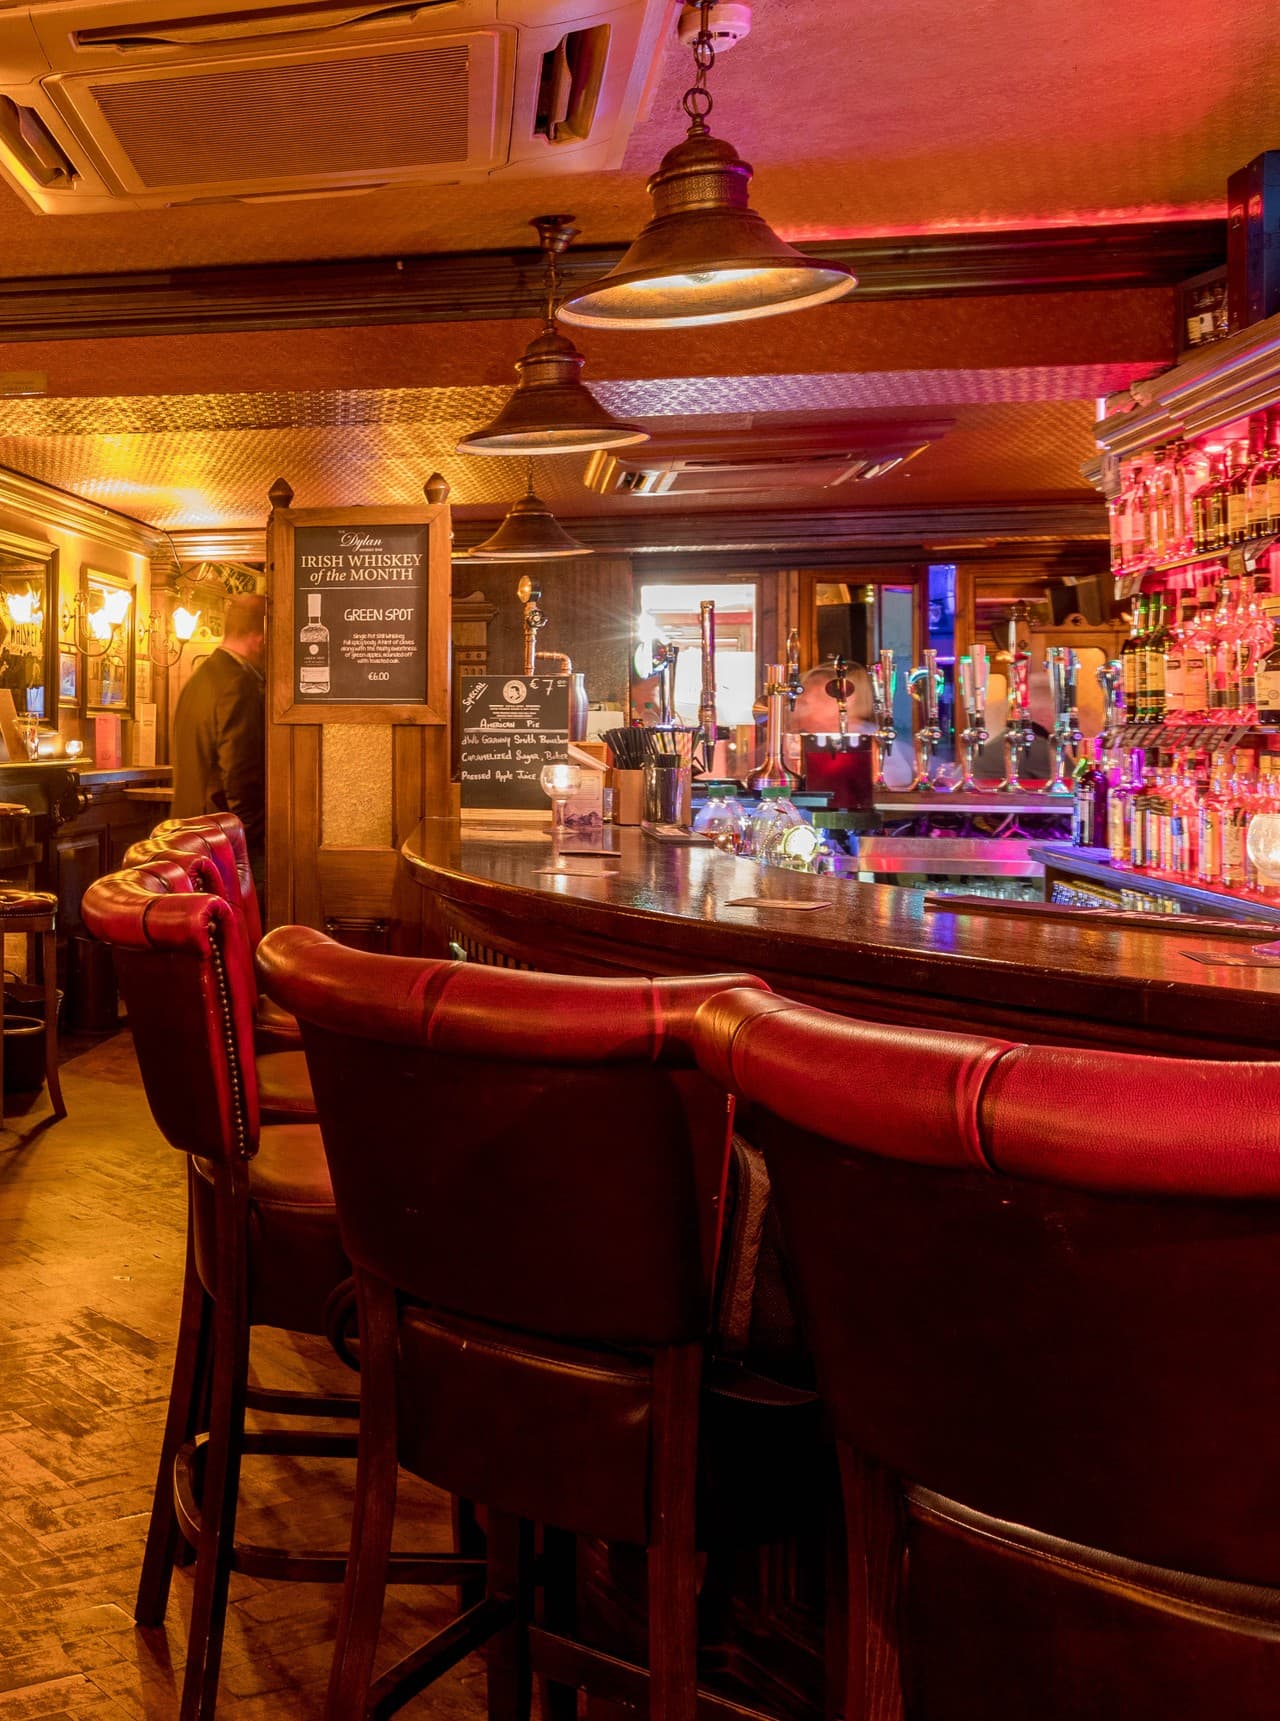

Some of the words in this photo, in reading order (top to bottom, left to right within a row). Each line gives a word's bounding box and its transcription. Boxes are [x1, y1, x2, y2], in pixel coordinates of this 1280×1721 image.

[339, 532, 383, 552] Dylan
[301, 555, 344, 568] IRISH
[348, 553, 423, 567] WHISKEY
[310, 568, 325, 585] of
[326, 568, 347, 582] the
[350, 567, 414, 581] MONTH
[344, 608, 383, 621] GREEN
[384, 608, 415, 621] SPOT
[368, 671, 390, 681] €6.00
